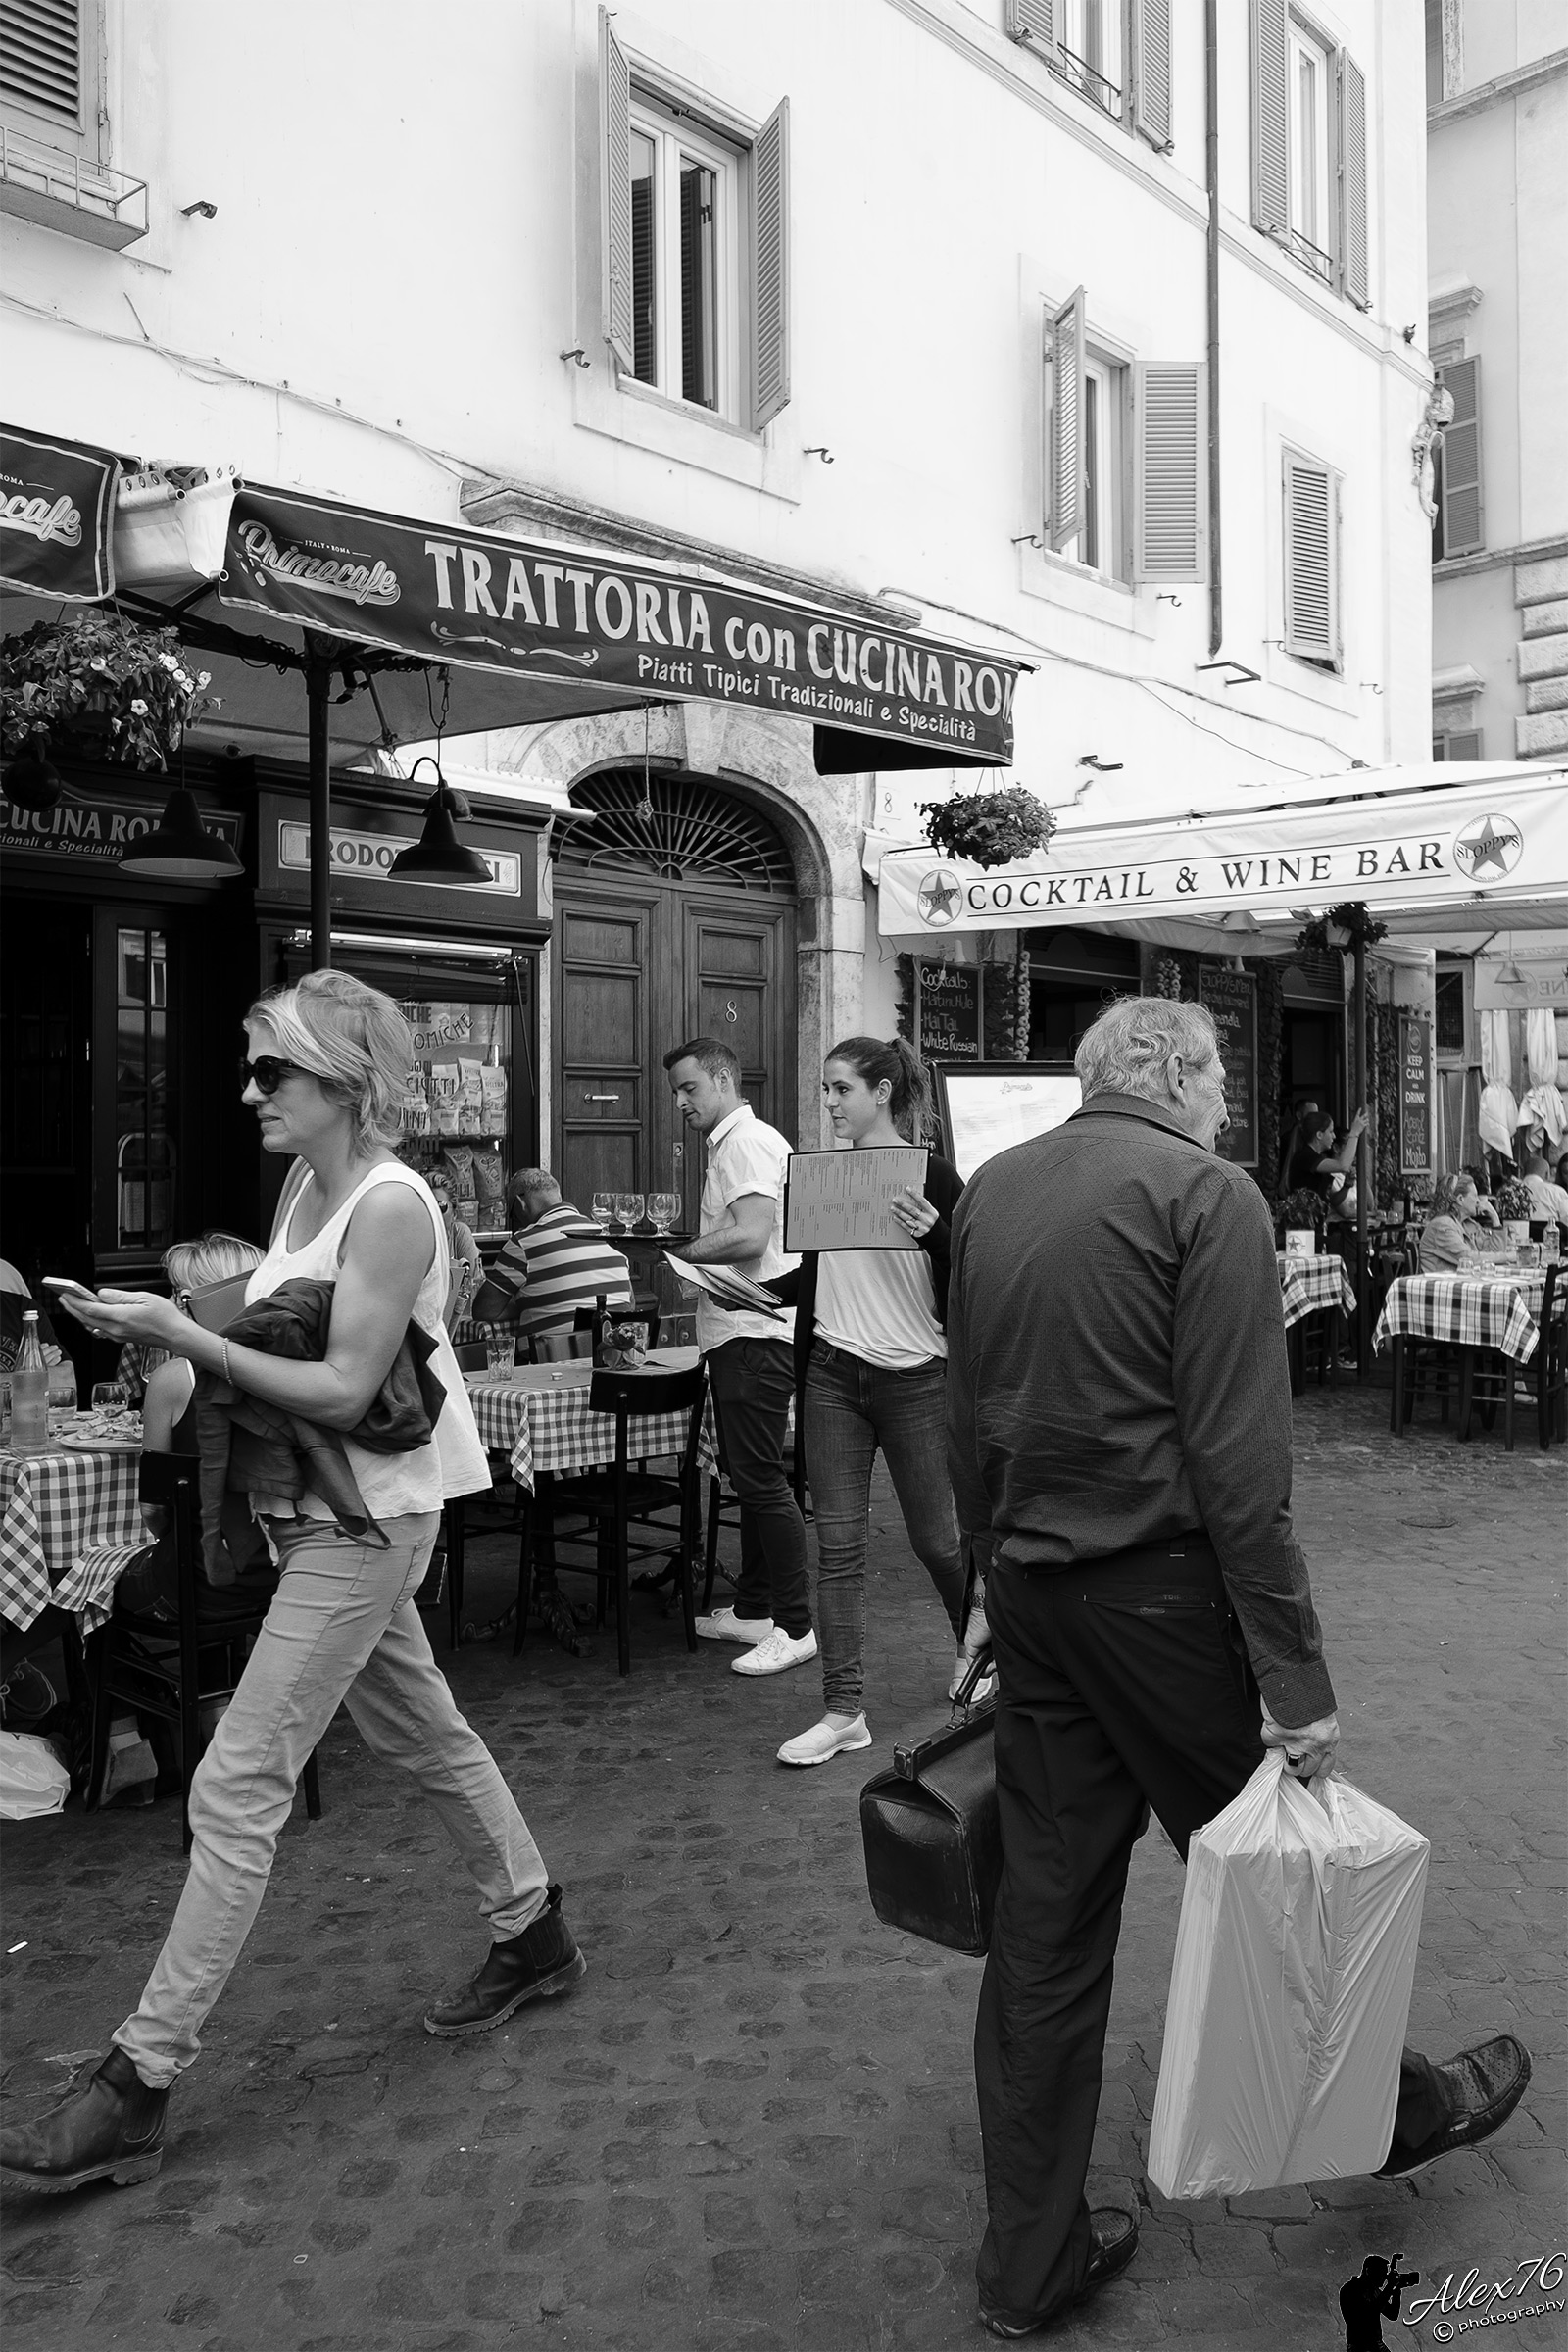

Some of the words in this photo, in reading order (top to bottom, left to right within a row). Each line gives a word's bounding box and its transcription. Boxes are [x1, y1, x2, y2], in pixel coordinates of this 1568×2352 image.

[305, 539, 325, 549] ITALY
[331, 545, 351, 555] ROMA
[238, 520, 402, 606] Primocafe
[424, 540, 715, 653] TRATTORIA
[725, 617, 797, 671] con
[807, 623, 948, 707] CUCINA
[638, 654, 693, 685] Piatti
[703, 663, 760, 697] Tipici
[767, 675, 874, 718] Tradizionali
[880, 706, 892, 721] e
[898, 705, 977, 741] Specialità
[884, 792, 893, 813] 8
[44, 840, 53, 849] e
[58, 839, 124, 857] Specialità
[967, 871, 1154, 909] COCKTAIL
[1176, 866, 1199, 893] &
[1221, 855, 1332, 889] WINE
[1356, 842, 1444, 876] BAR
[725, 1000, 737, 1023] 8
[1407, 1054, 1423, 1066] KEEP
[1406, 1068, 1425, 1080] CALM
[1406, 1091, 1426, 1103] DRINK
